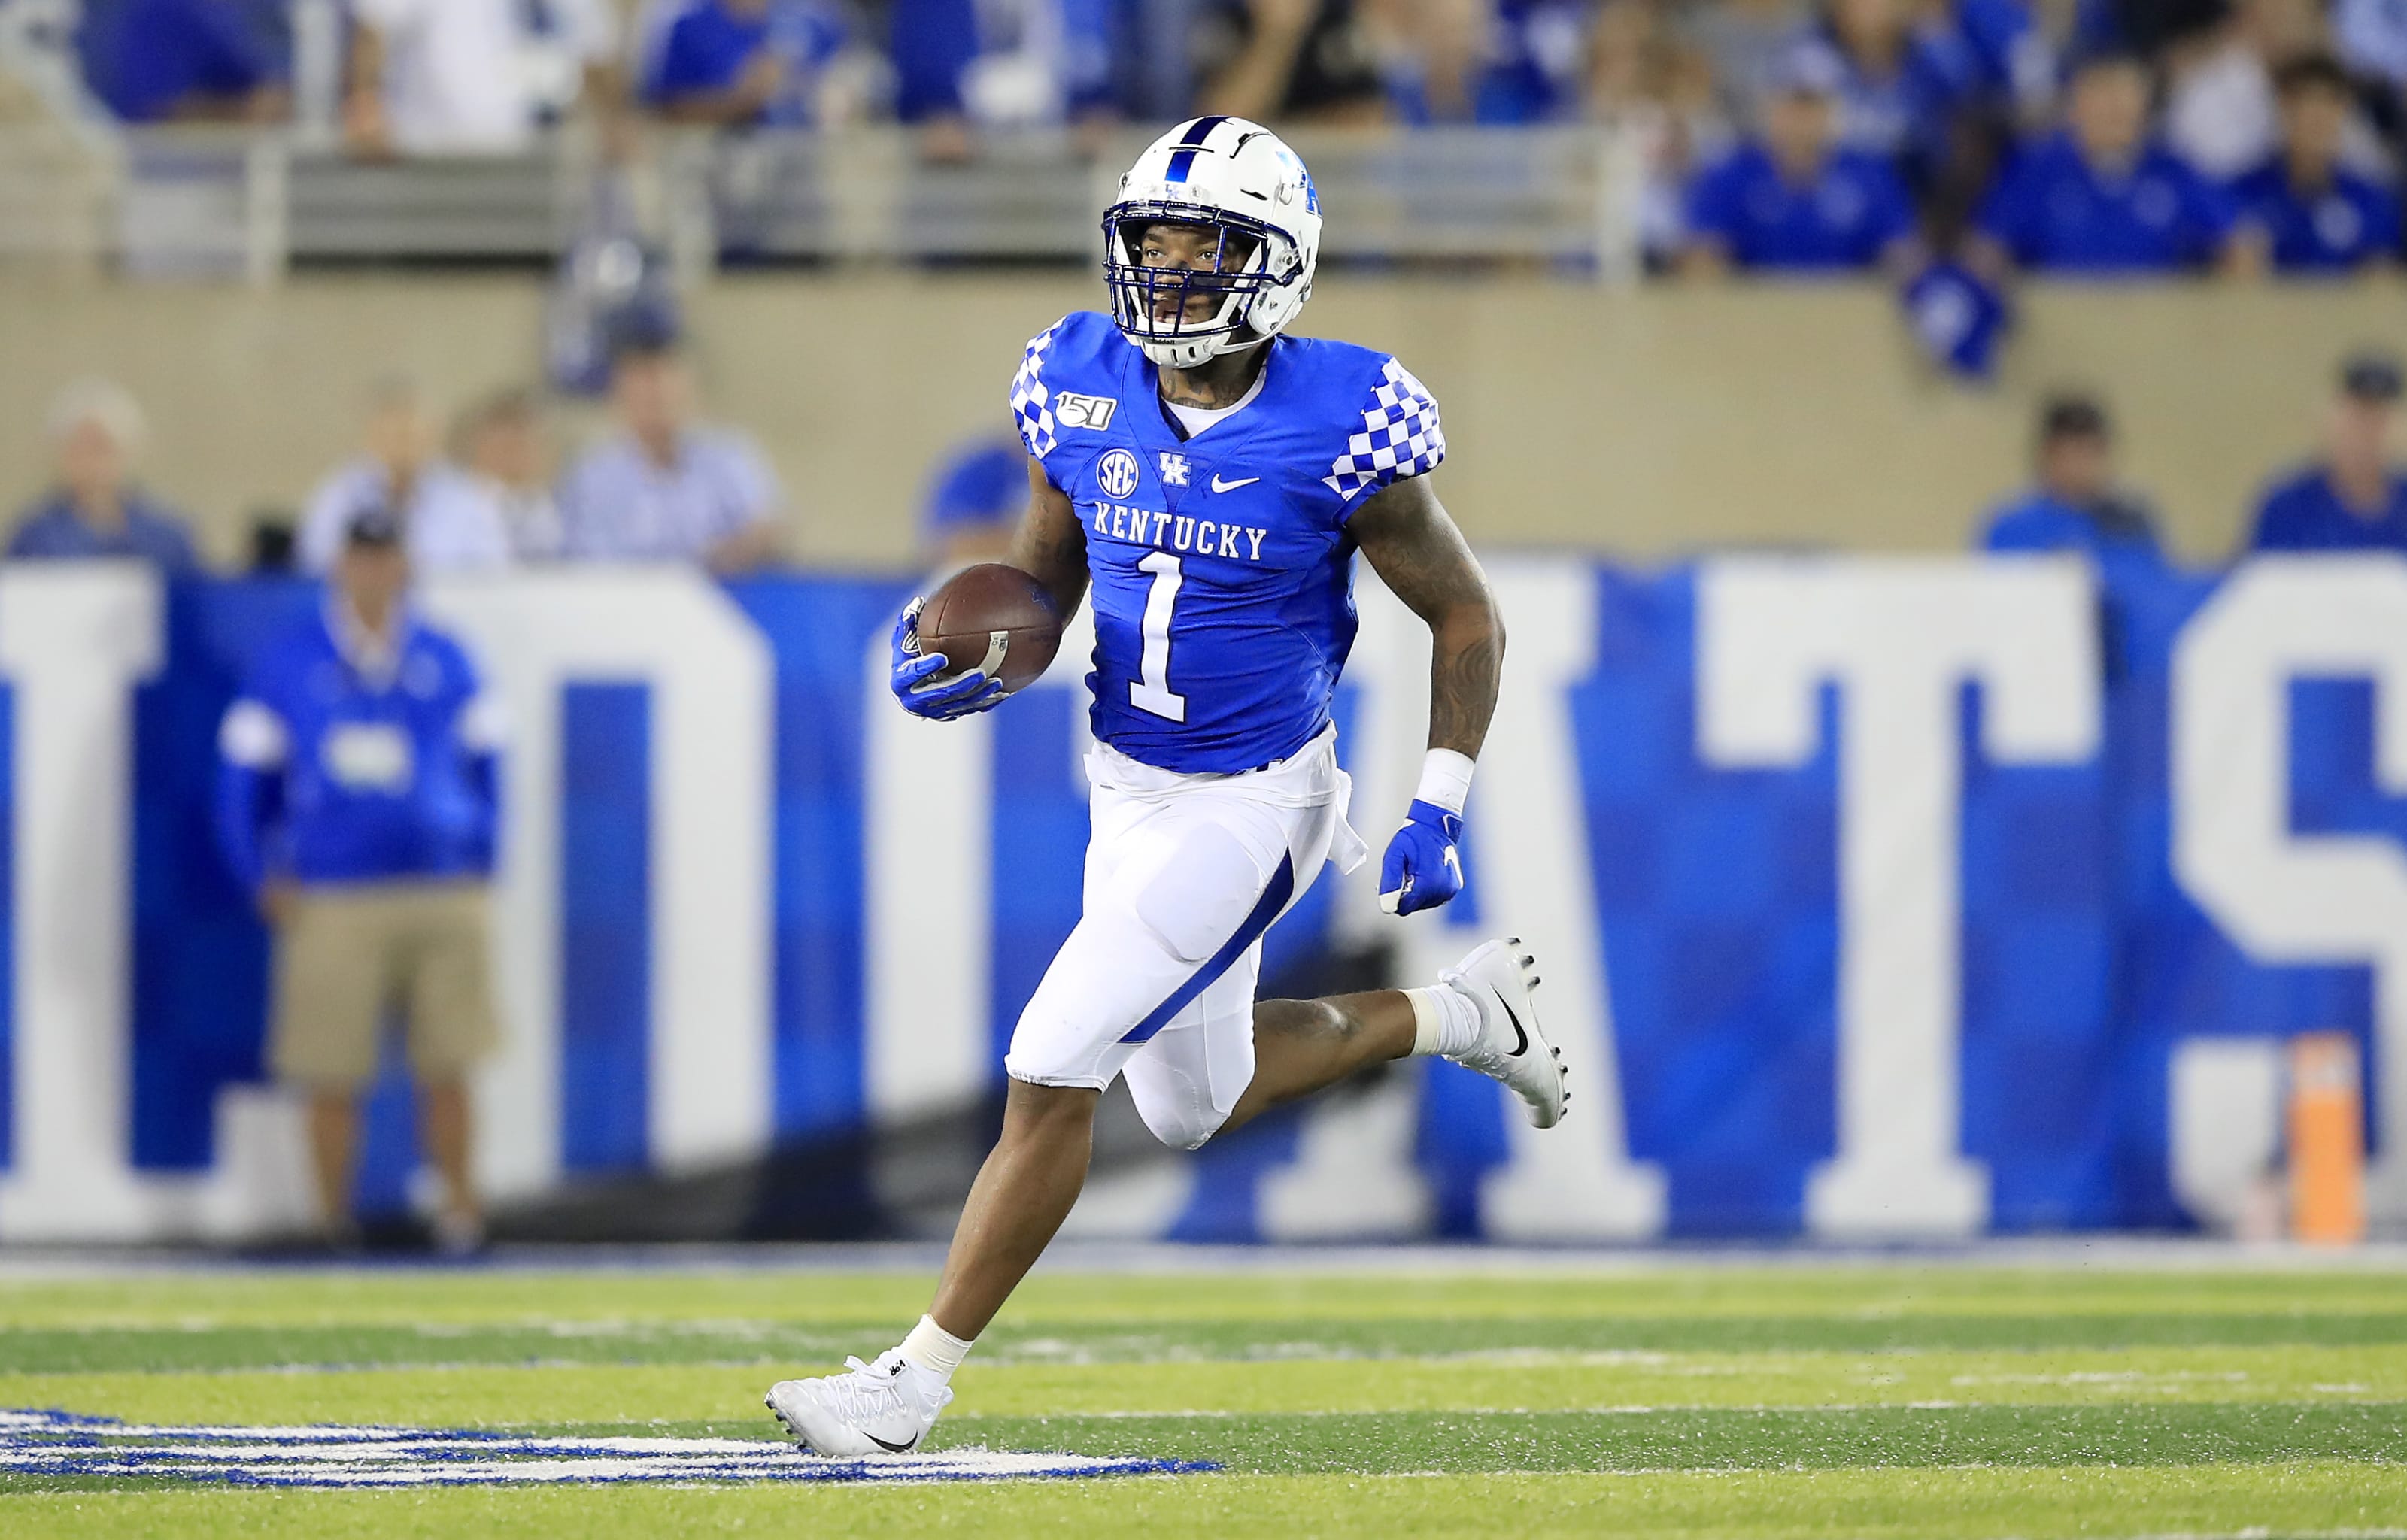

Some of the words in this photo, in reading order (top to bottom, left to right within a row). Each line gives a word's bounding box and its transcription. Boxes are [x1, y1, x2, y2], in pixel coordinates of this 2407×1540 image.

[1056, 393, 1115, 429] 150
[1100, 451, 1135, 496] SEC
[1094, 501, 1267, 560] KENTUCKY
[1130, 550, 1185, 722] 1
